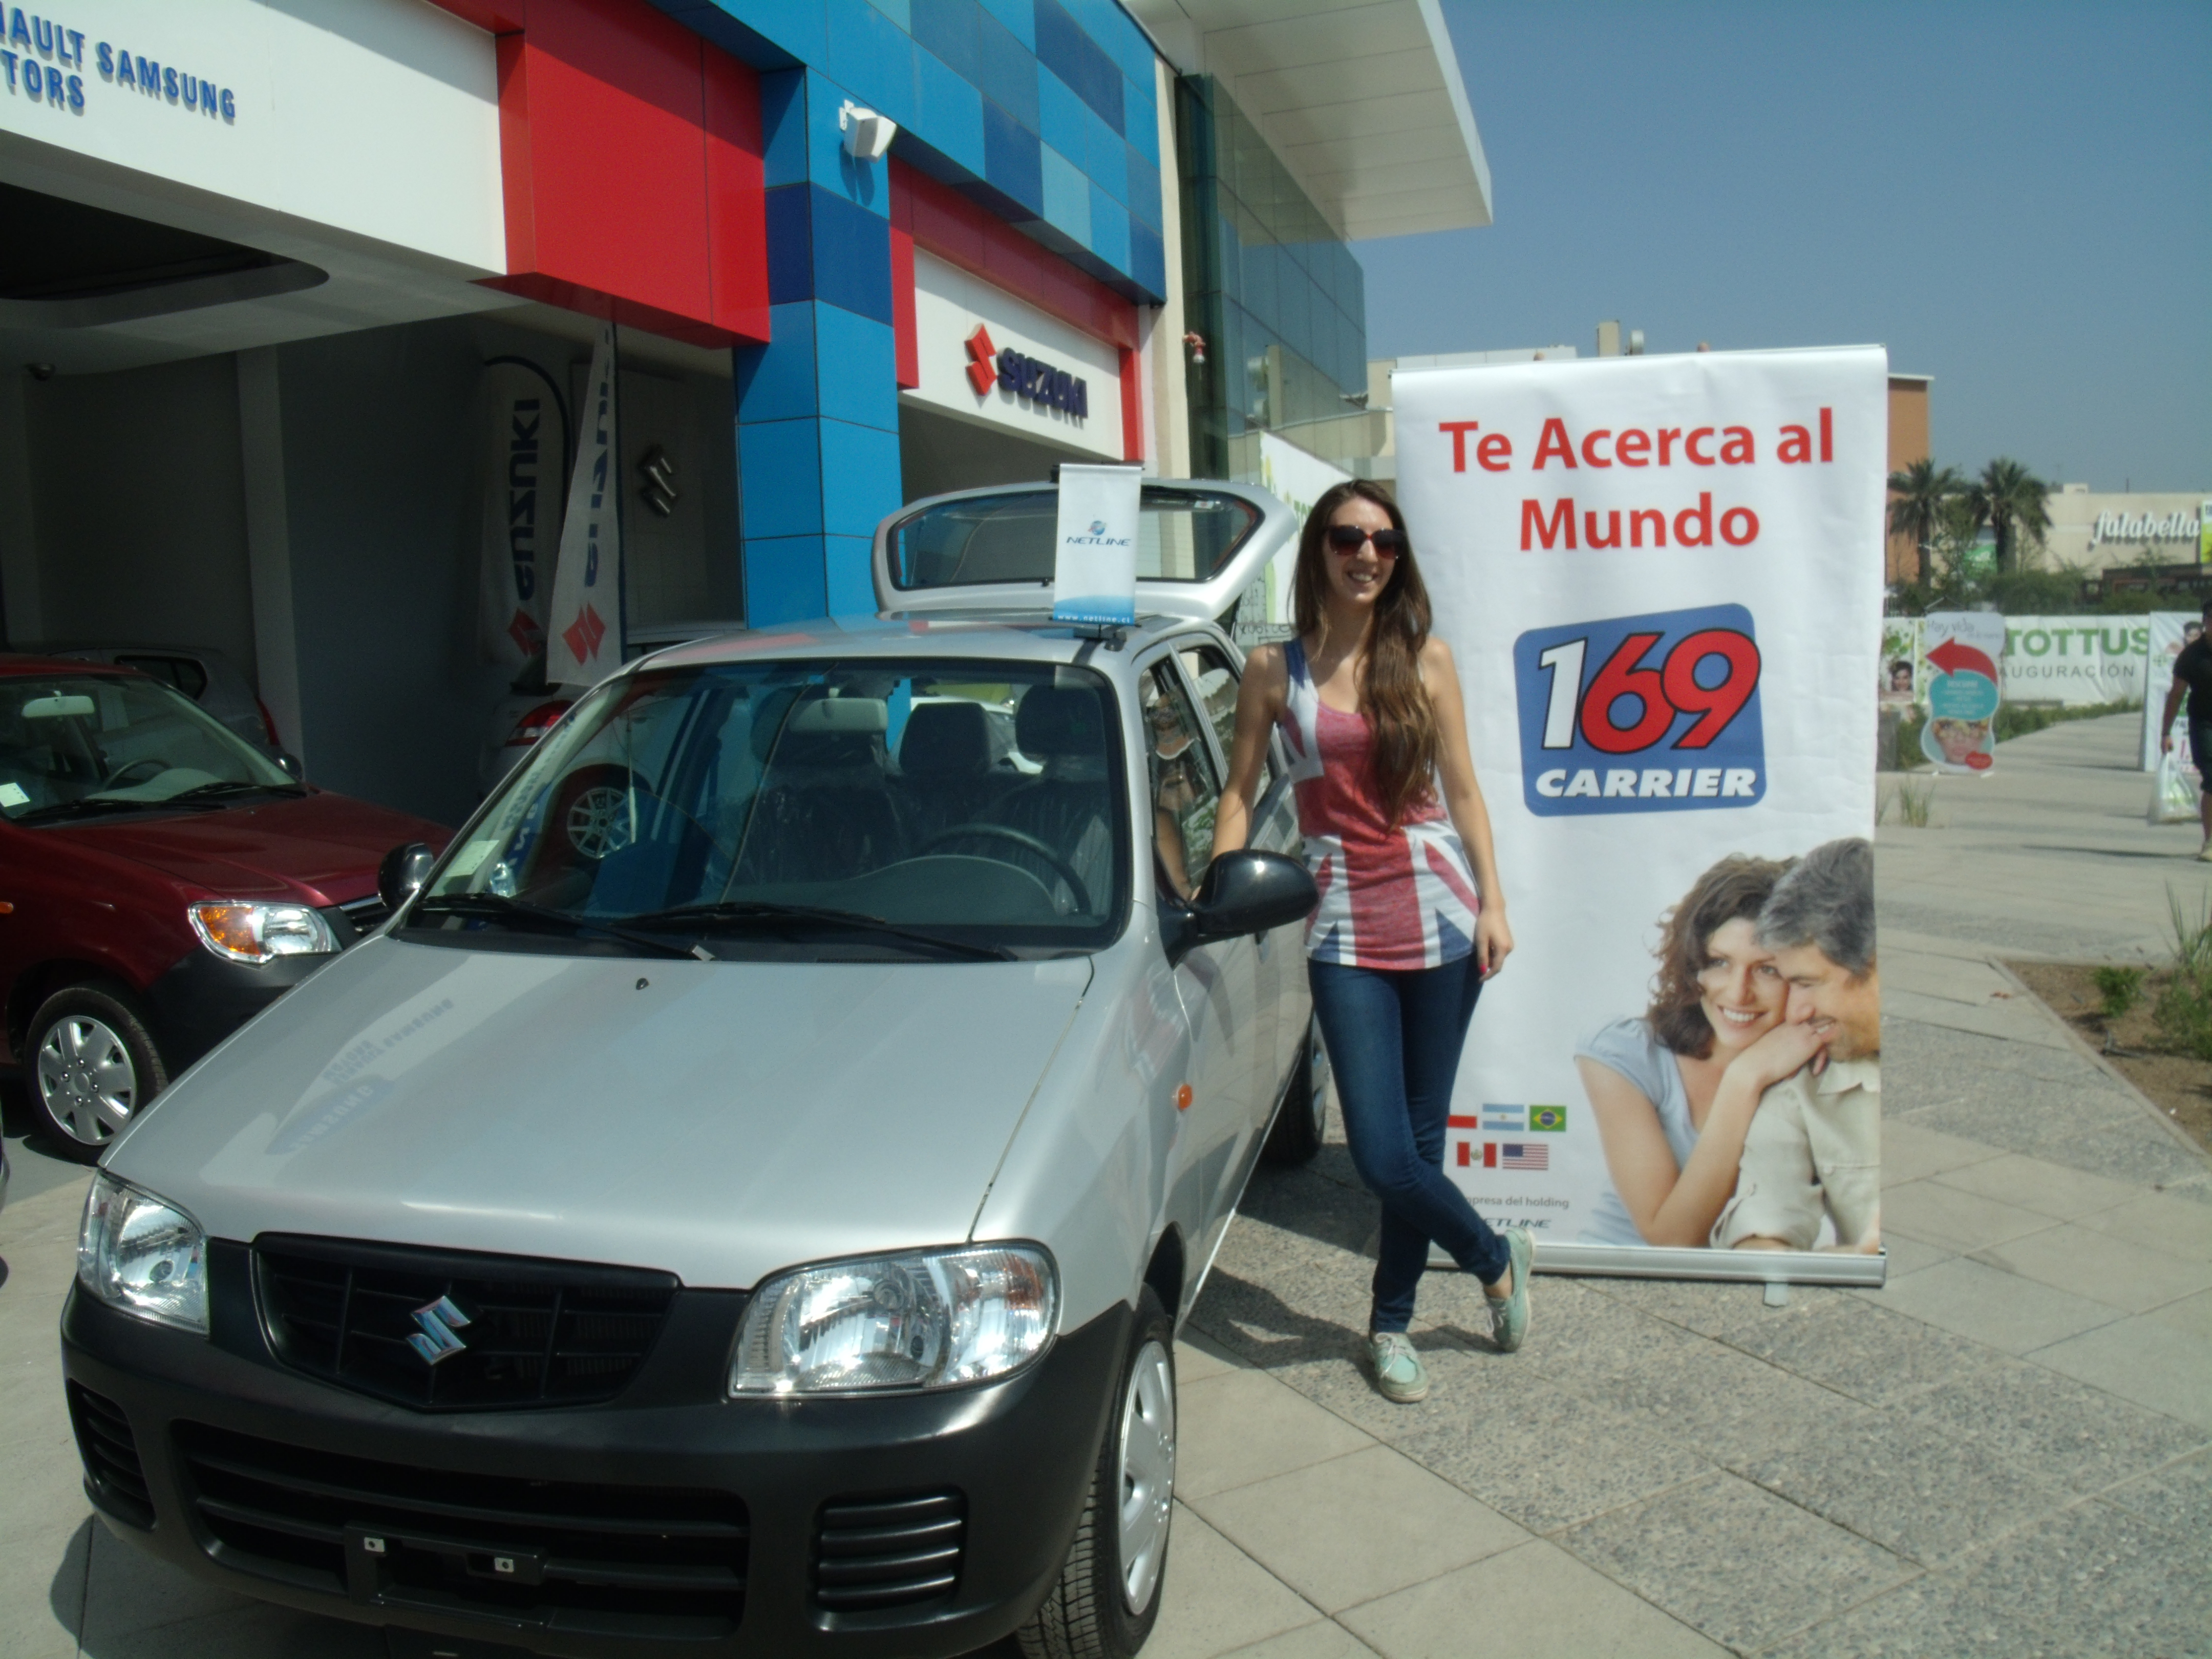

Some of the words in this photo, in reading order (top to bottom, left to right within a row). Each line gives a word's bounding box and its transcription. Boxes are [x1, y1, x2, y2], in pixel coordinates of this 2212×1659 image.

[96, 41, 236, 120] SAMSUNG
[996, 347, 1088, 419] SUZUKI
[1439, 421, 1512, 473] Te
[1533, 418, 1755, 470] Acerca
[1776, 407, 1834, 463] al
[1520, 492, 1760, 551] Mundo
[2091, 510, 2200, 544] falabella
[1067, 537, 1131, 546] NETLINE
[1058, 614, 1130, 623] www.netline.cl
[2004, 628, 2149, 656] TOTTUS
[1538, 628, 1761, 755] 169
[1536, 769, 1756, 798] CARRIER
[1505, 1196, 1522, 1205] del
[1526, 1197, 1569, 1209] holding
[1485, 1218, 1551, 1228] ETLINE
